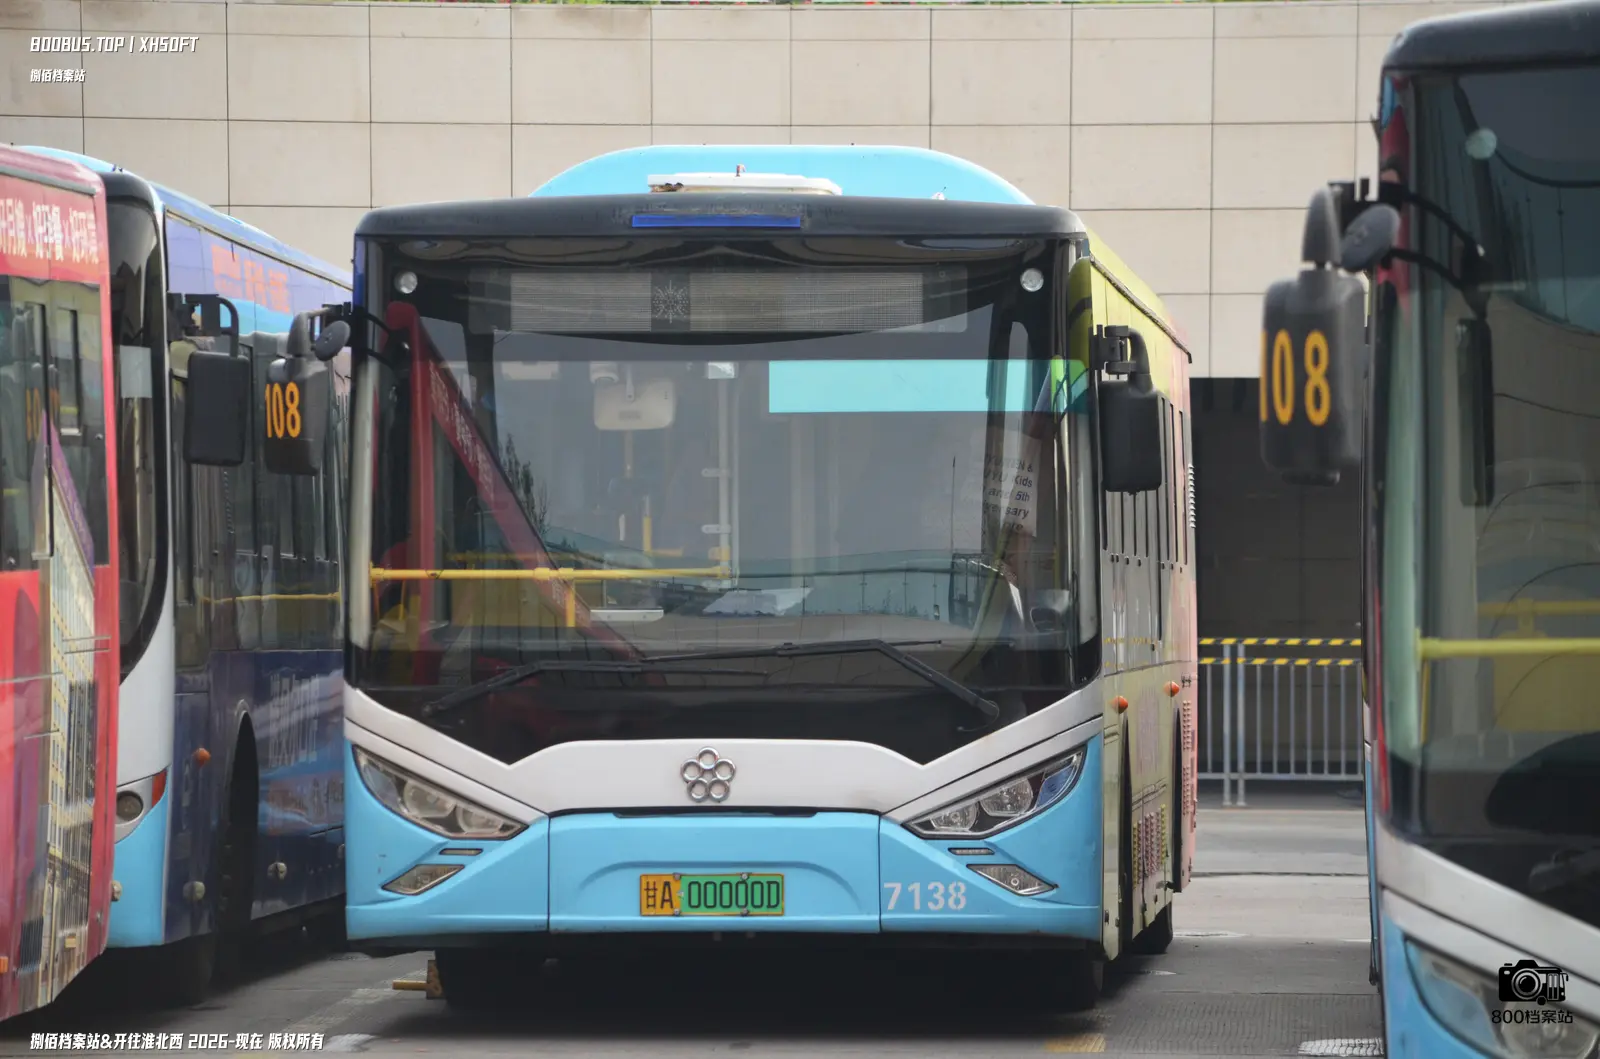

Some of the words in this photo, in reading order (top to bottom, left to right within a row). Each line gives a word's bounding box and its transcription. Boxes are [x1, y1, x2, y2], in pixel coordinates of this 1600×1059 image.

[1259, 328, 1332, 427] 108
[264, 381, 301, 439] 108
[643, 881, 675, 909] 甘A
[687, 880, 781, 909] 00000D
[883, 881, 967, 911] 7138
